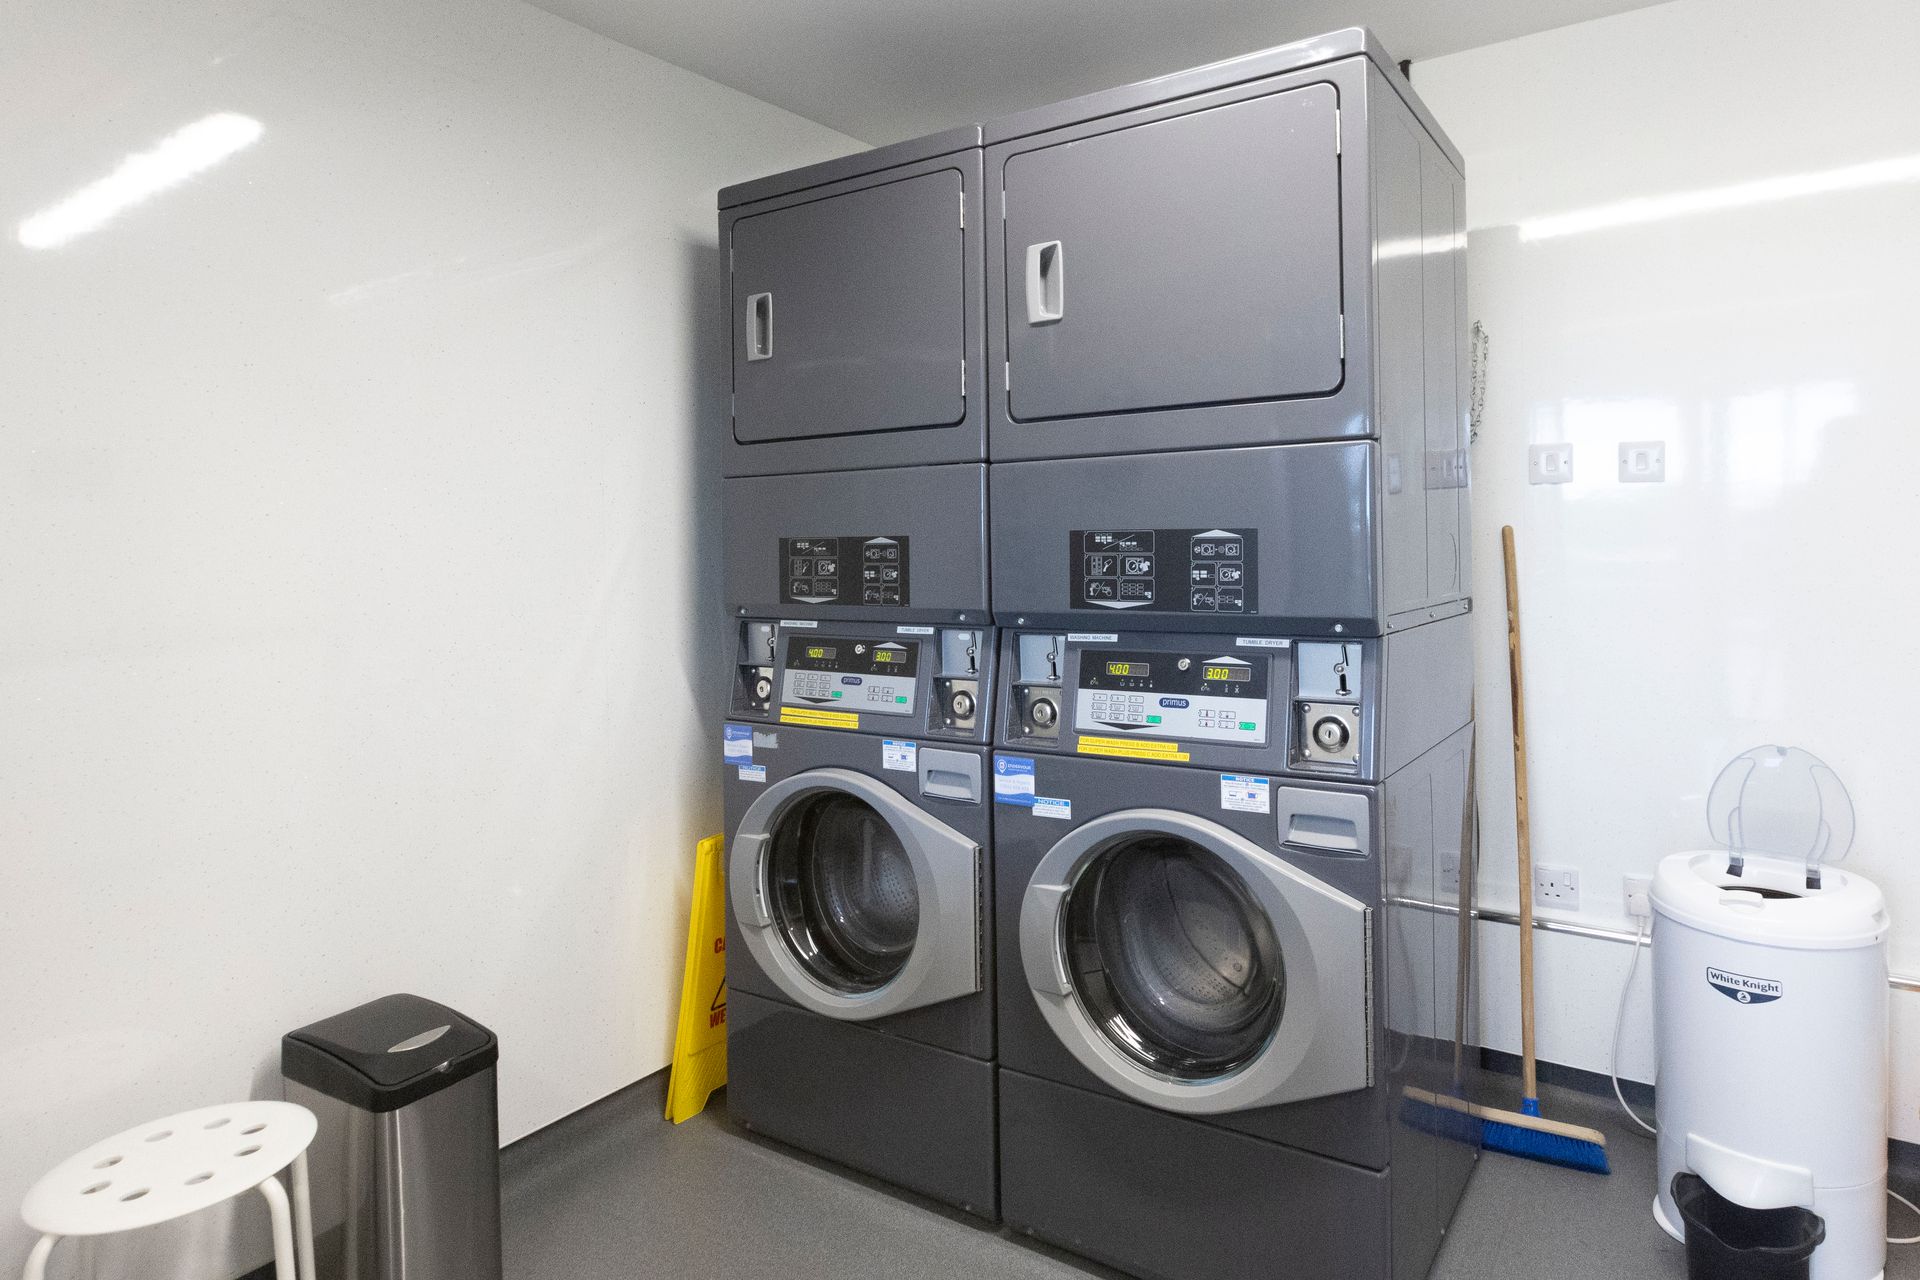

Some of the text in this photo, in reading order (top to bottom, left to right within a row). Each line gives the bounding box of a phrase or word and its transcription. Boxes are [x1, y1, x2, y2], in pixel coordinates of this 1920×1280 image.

[808, 648, 824, 658] 4.00
[876, 652, 892, 661] 3.00
[1110, 664, 1130, 674] 4.00
[1207, 668, 1228, 680] 3.00
[1162, 698, 1187, 706] primus
[1710, 971, 1779, 992] White Knight
